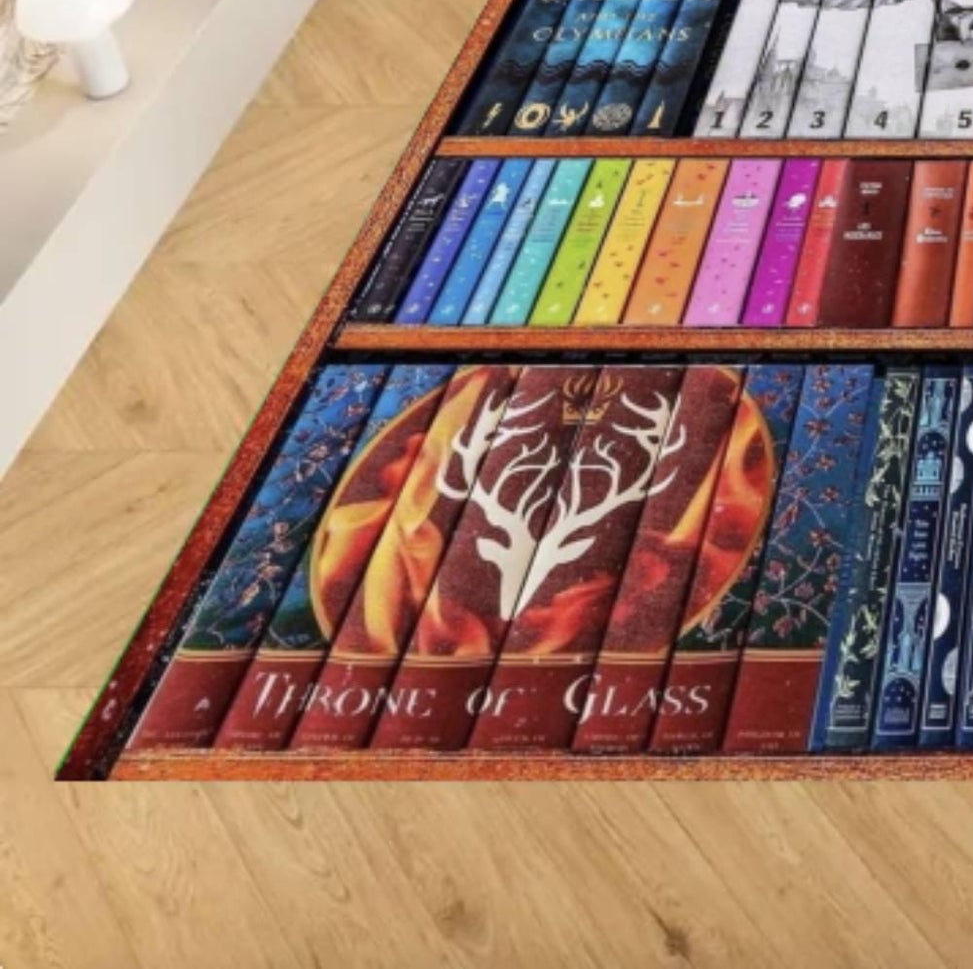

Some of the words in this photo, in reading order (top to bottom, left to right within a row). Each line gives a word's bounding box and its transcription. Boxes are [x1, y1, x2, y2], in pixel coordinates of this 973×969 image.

[532, 26, 691, 42] OLYMPIANS
[709, 111, 725, 129] 1
[755, 111, 774, 129] 2
[809, 111, 826, 129] 3
[873, 111, 889, 129] 4
[957, 110, 973, 129] 5
[252, 671, 437, 719] THRONE
[562, 672, 711, 725] GLASS
